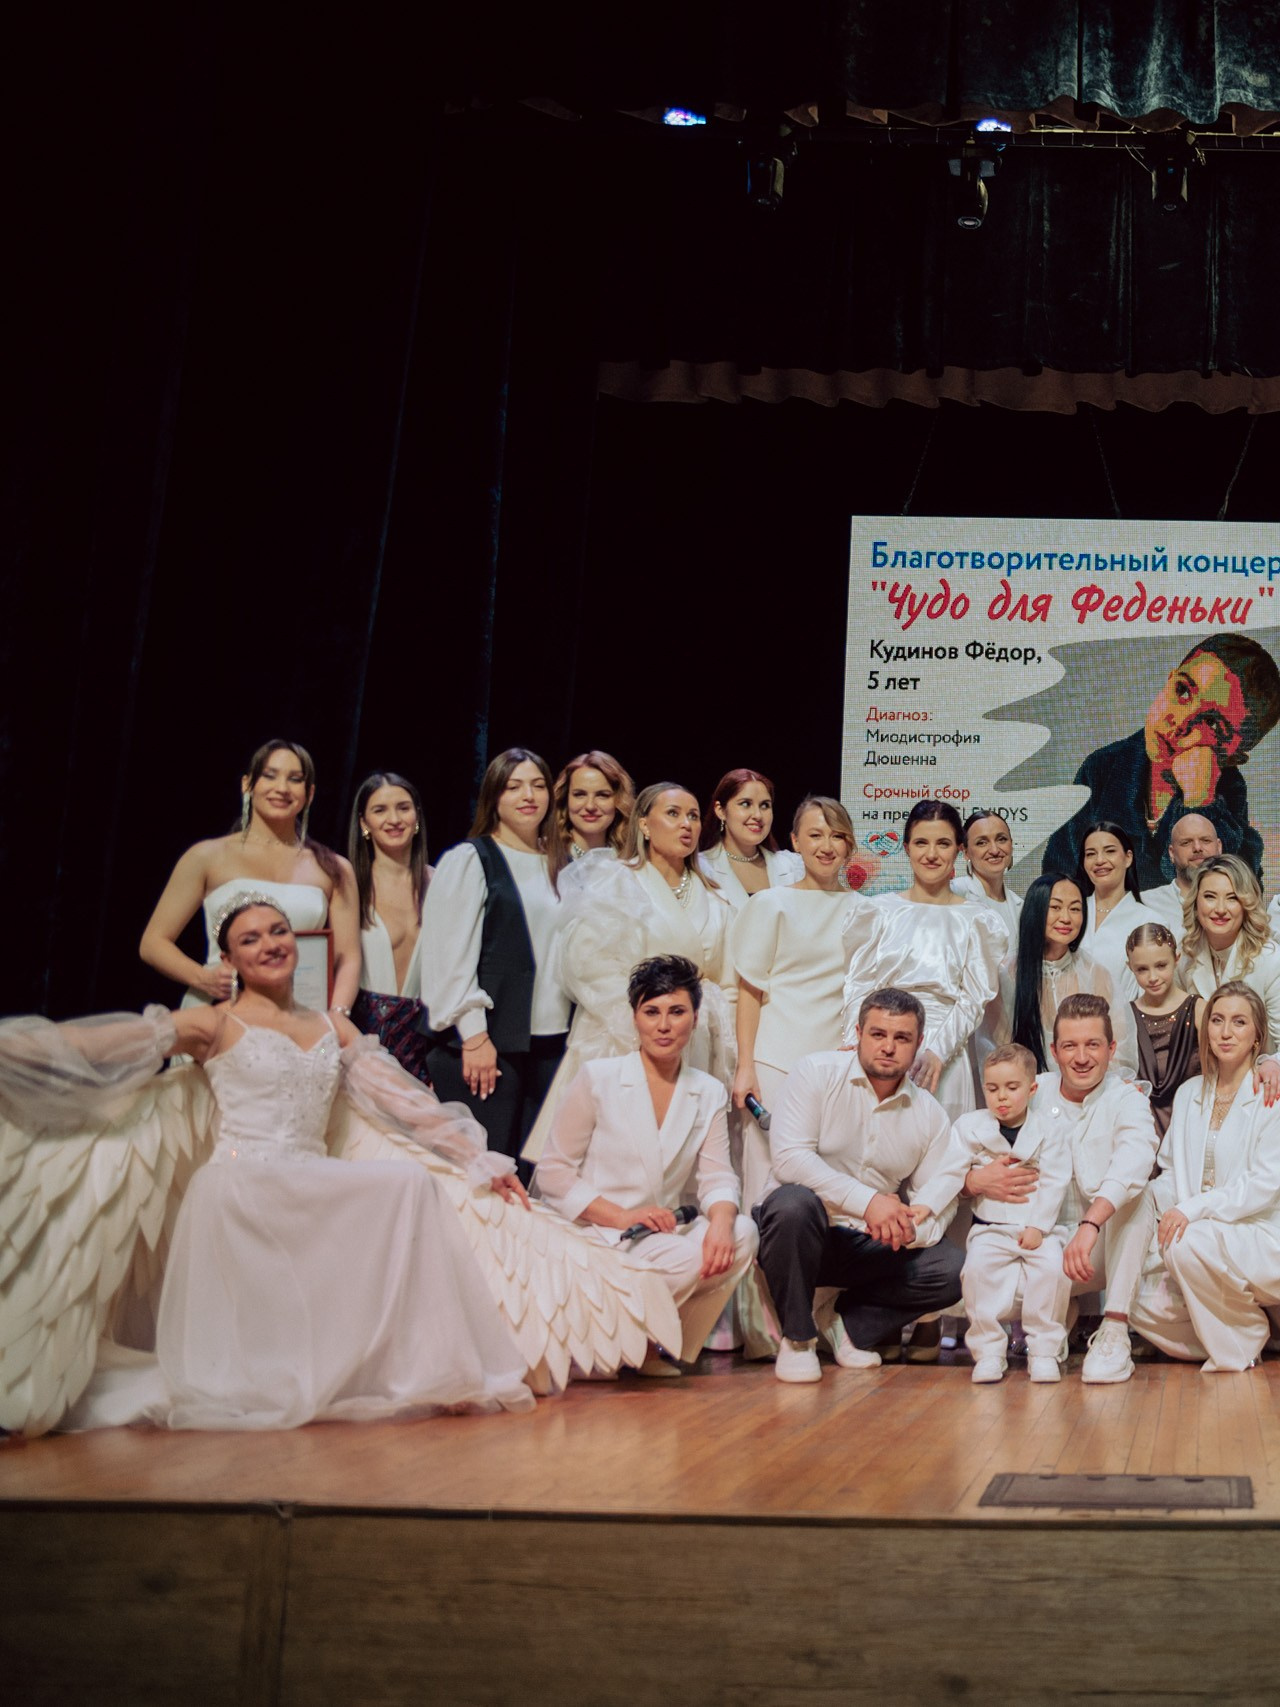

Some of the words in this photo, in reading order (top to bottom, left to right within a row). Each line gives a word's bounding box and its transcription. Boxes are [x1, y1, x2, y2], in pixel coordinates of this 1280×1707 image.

[870, 541, 1169, 577] Благотворительный
[871, 578, 970, 631] "Чудо
[987, 579, 1053, 625] для
[1071, 580, 1275, 626] Феденьки"
[869, 639, 959, 663] Кудинов
[965, 640, 1042, 665] Фёдор,
[867, 671, 880, 690] 5
[885, 677, 921, 690] лет
[866, 706, 933, 722] Диагноз:
[866, 728, 981, 747] Миодистрофия
[864, 750, 937, 767] Дюшенна
[863, 783, 930, 801] Срочный
[934, 784, 970, 802] сбор
[862, 810, 879, 820] на
